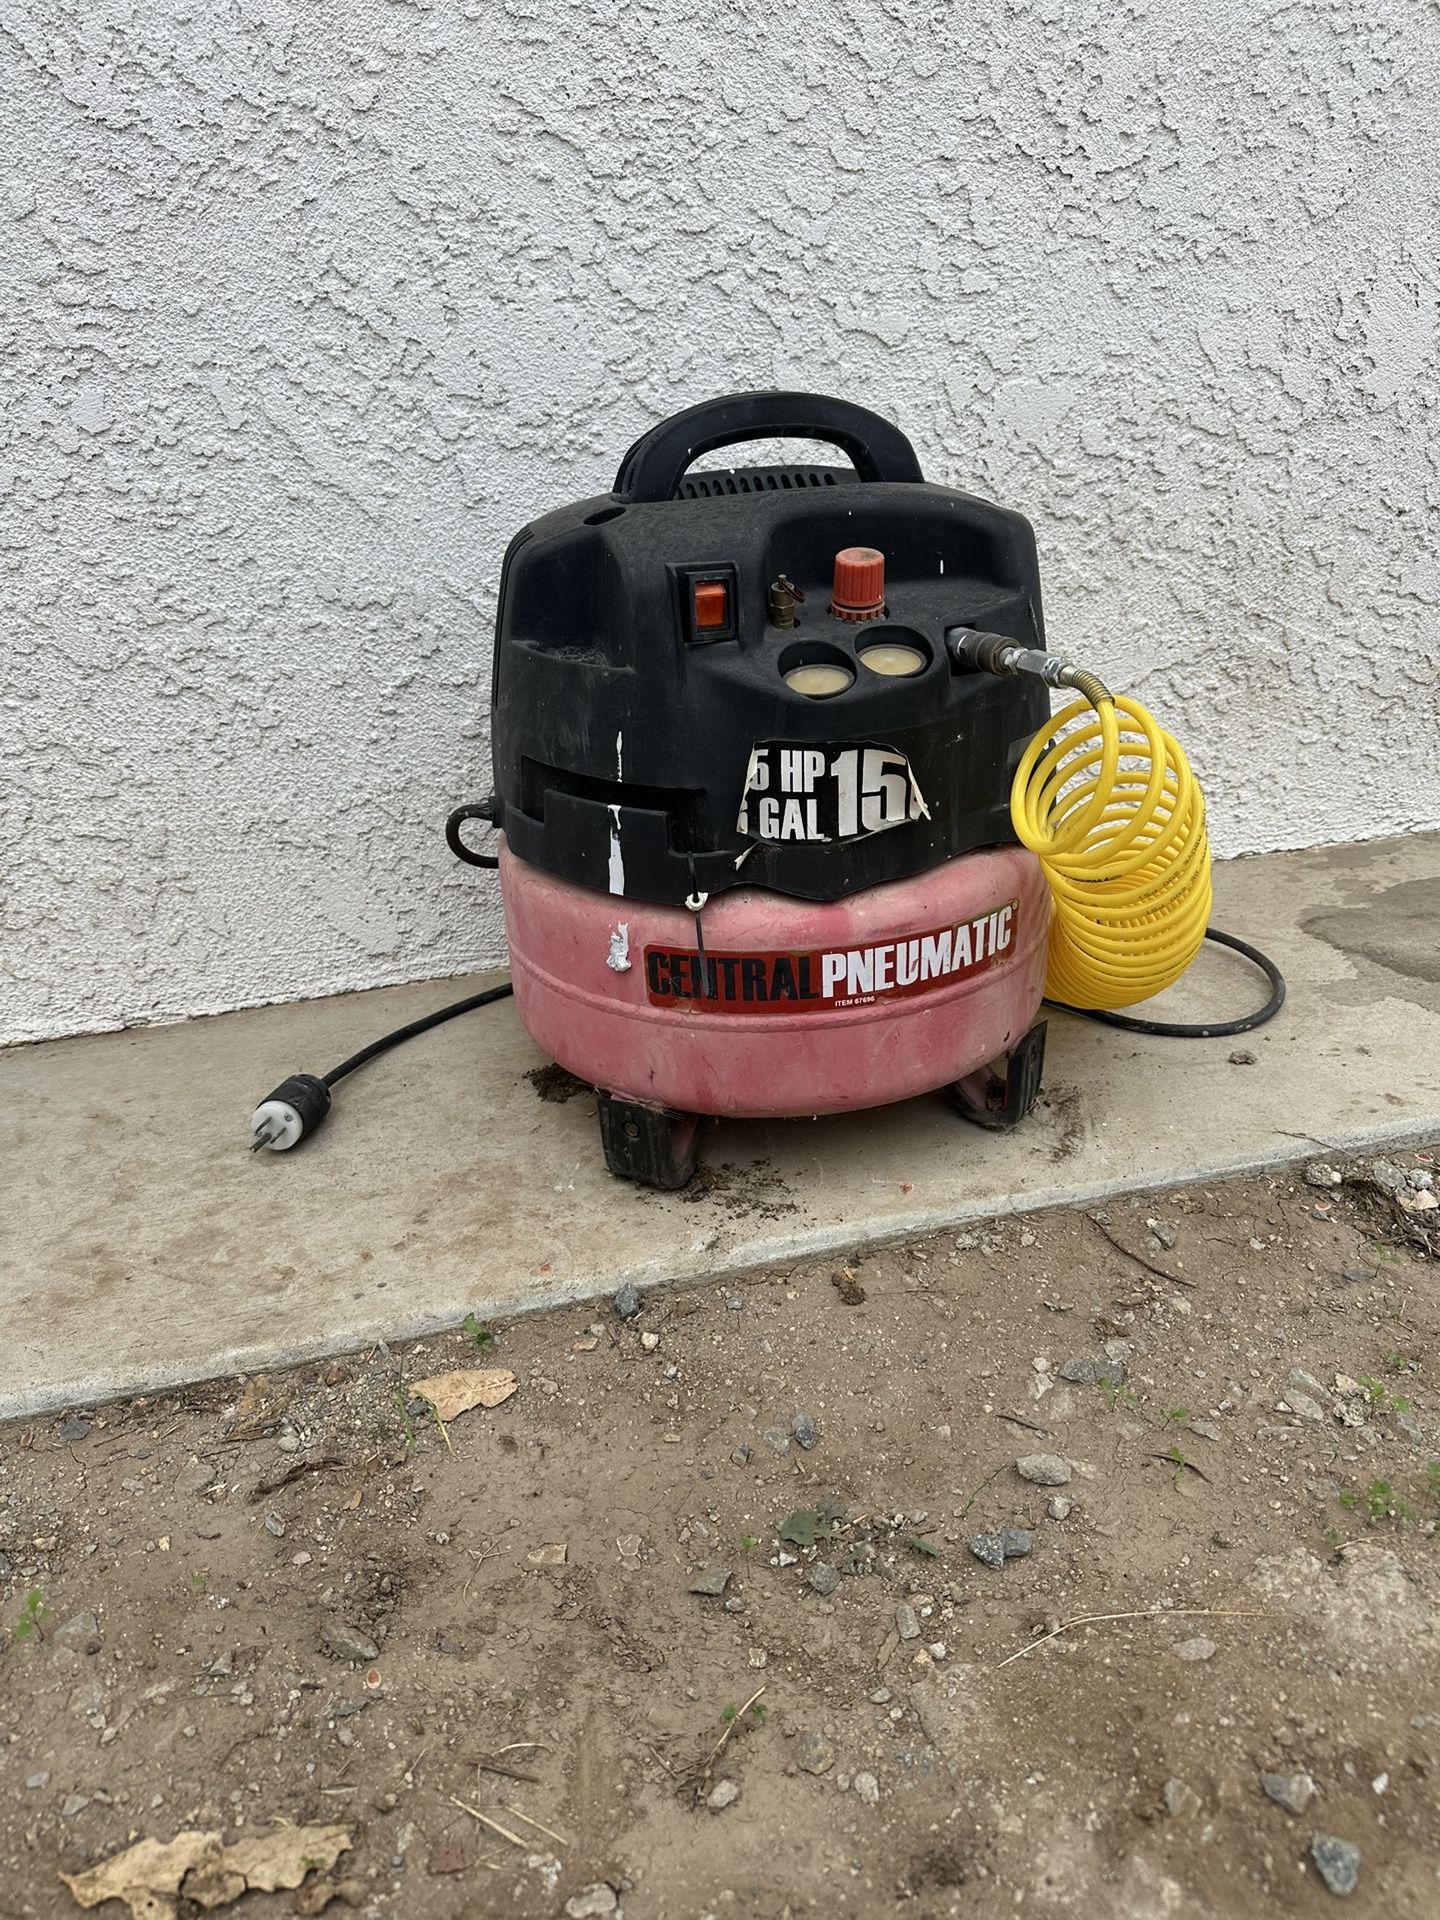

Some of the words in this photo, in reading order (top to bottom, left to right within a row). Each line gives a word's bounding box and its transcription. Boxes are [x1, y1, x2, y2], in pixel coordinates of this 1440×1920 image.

[780, 749, 826, 793] HP
[830, 749, 923, 837] 15
[759, 797, 826, 840] GAL
[1162, 870, 1180, 888] 200
[647, 952, 820, 1001] CENTRAL
[821, 905, 1013, 999] PNEUMATIC
[834, 998, 854, 1007] ITEM
[853, 995, 876, 1005] 67696
